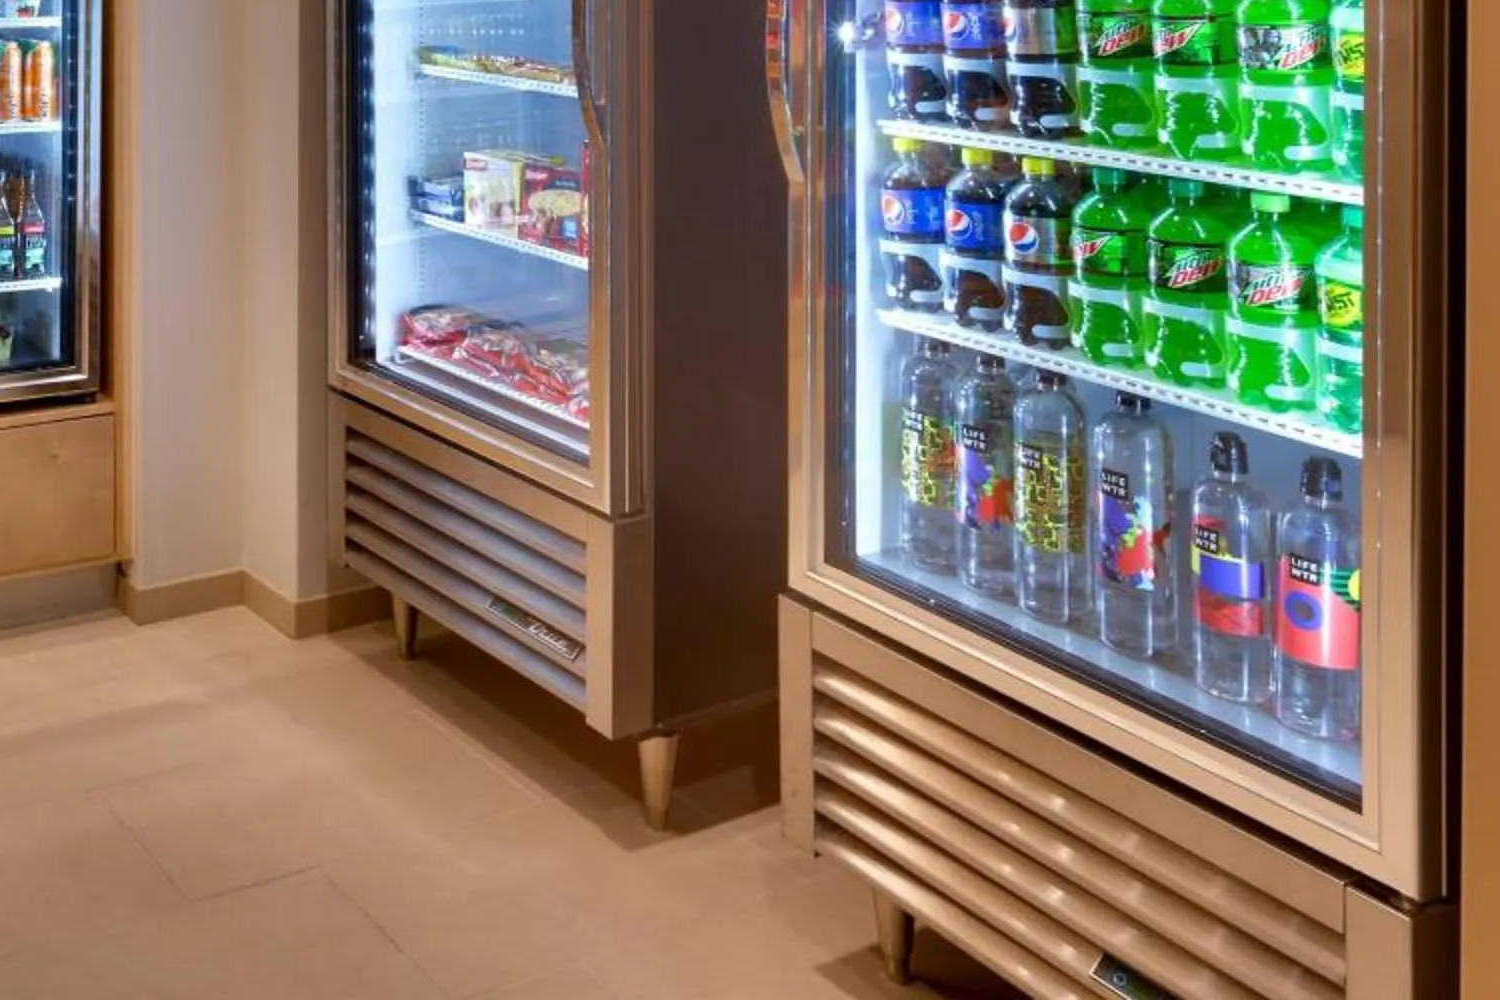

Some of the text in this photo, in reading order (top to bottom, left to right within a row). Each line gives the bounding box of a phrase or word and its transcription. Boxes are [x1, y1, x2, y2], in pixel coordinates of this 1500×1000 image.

[963, 427, 987, 441] LIFE
[1101, 471, 1126, 486] LIFE
[1101, 483, 1126, 497] WTR
[1194, 527, 1217, 542] LIFE
[1290, 555, 1318, 572] LIFE
[1290, 566, 1318, 582] WTR
